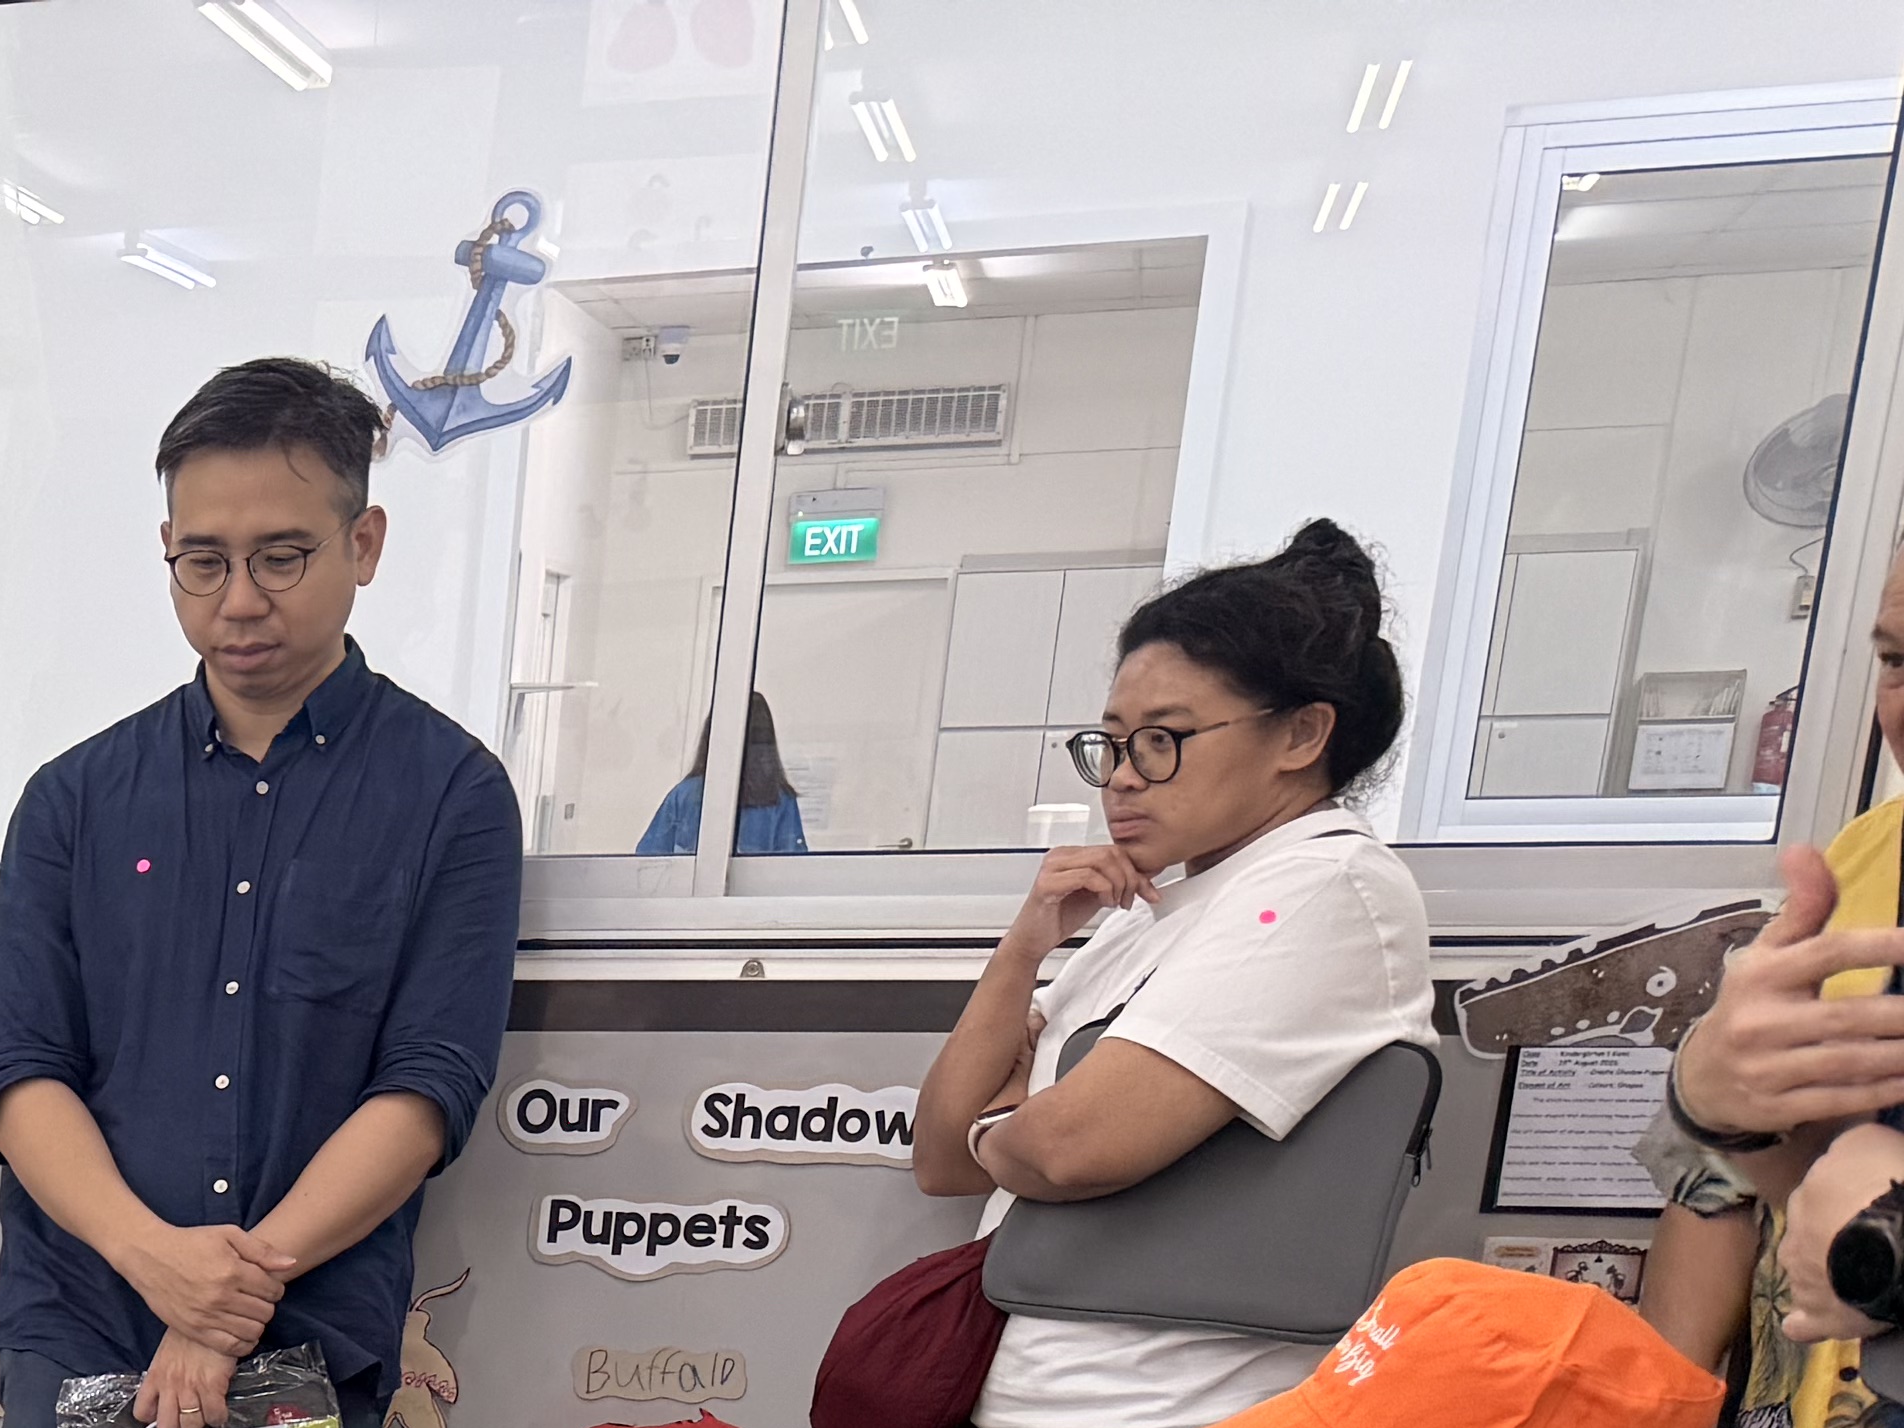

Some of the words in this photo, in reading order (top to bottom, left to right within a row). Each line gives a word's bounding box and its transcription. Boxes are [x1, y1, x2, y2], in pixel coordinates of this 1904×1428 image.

[804, 524, 865, 556] EXIT
[517, 1088, 620, 1134] Our
[700, 1092, 914, 1147] Shadow
[547, 1198, 772, 1257] Puppets
